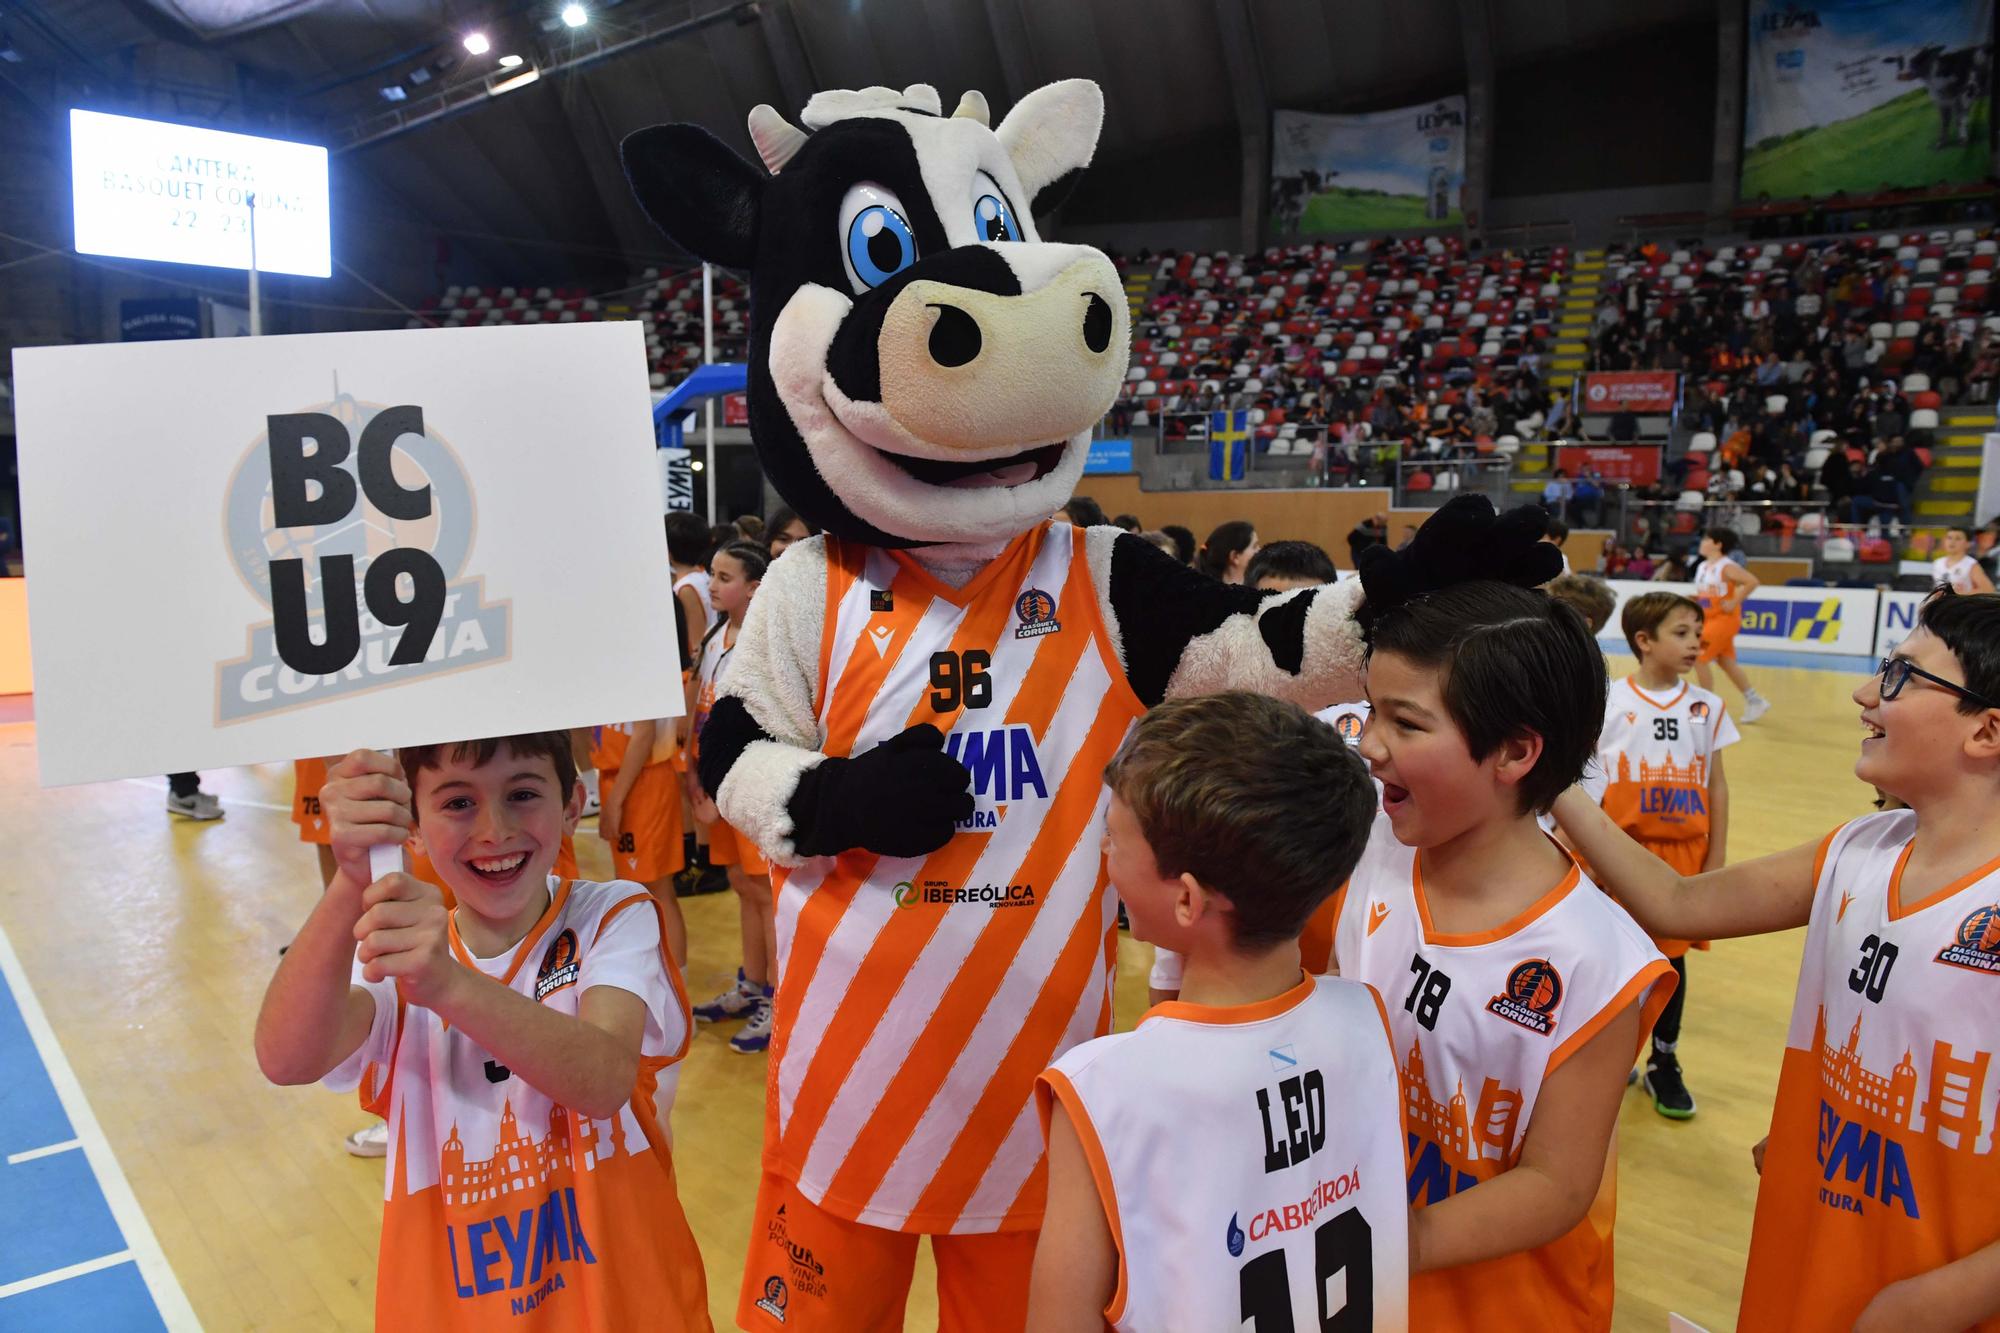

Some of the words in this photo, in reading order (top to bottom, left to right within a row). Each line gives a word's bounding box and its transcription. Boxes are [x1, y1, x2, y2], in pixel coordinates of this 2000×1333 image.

[103, 170, 204, 201] BASQUET
[172, 208, 197, 228] 22
[266, 404, 432, 529] BC
[667, 456, 692, 511] EYMA
[268, 547, 447, 676] U9
[1022, 620, 1054, 630] BASQUET
[929, 650, 993, 713] 96
[1653, 718, 1679, 741] 35
[1640, 787, 1706, 816] LEYMA
[923, 884, 1035, 904] IBEREÓLICA
[989, 900, 1035, 909] RENOVABLES
[1848, 934, 1899, 1004] 30
[1951, 946, 1999, 961] BASQUET
[538, 964, 575, 989] BASQUET
[1404, 953, 1451, 1032] 78
[1502, 999, 1546, 1021] BASQUET
[1256, 1069, 1326, 1174] LEO
[1249, 1164, 1361, 1242] CABREIROÁ
[447, 1187, 597, 1299] LEYMA
[511, 1272, 566, 1316] NATURA
